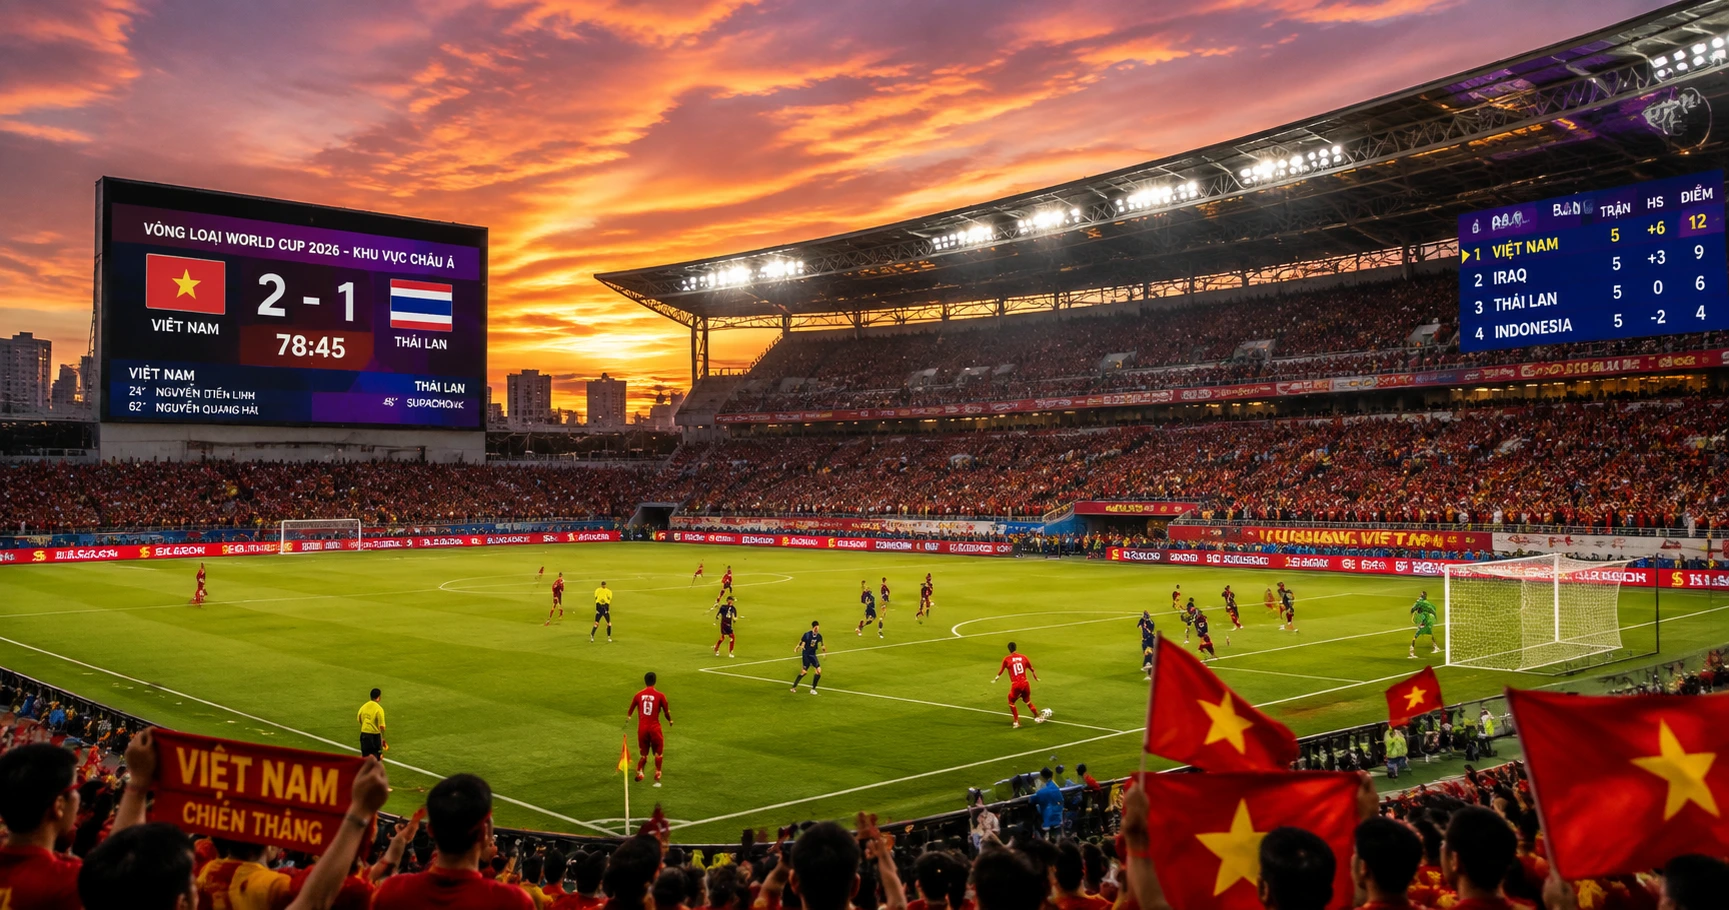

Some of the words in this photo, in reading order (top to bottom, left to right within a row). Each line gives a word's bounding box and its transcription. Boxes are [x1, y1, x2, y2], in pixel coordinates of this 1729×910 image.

[1647, 196, 1664, 209] HS
[189, 227, 222, 246] LOẠI
[225, 231, 275, 249] WORLD
[278, 238, 306, 252] CUP
[308, 241, 340, 257] 2026
[353, 247, 379, 260] KHU
[1474, 248, 1481, 261] 1
[1526, 237, 1559, 254] NAM
[1611, 228, 1620, 242] 5
[1647, 220, 1666, 235] +6
[1689, 213, 1707, 230] 12
[1474, 274, 1483, 288] 2
[1493, 267, 1527, 286] IRAQ
[1612, 257, 1621, 271] 5
[1647, 250, 1666, 265] +3
[1694, 245, 1704, 260] 9
[257, 272, 286, 317] 2
[337, 281, 354, 322] 1
[1475, 301, 1484, 315] 3
[1529, 291, 1558, 308] LAN
[1613, 285, 1622, 299] 5
[1653, 280, 1664, 295] 0
[1695, 276, 1705, 291] 6
[187, 321, 219, 335] NAM
[1475, 327, 1485, 341] 4
[1494, 317, 1573, 340] INDONESIA
[1613, 314, 1623, 328] 5
[1650, 310, 1666, 325] -2
[1695, 304, 1706, 321] 4
[276, 333, 346, 359] 78:45
[424, 338, 447, 350] LAN
[164, 368, 195, 381] NAM
[443, 382, 466, 394] LAN
[176, 743, 253, 800] VIỆT
[261, 758, 340, 807] NAM
